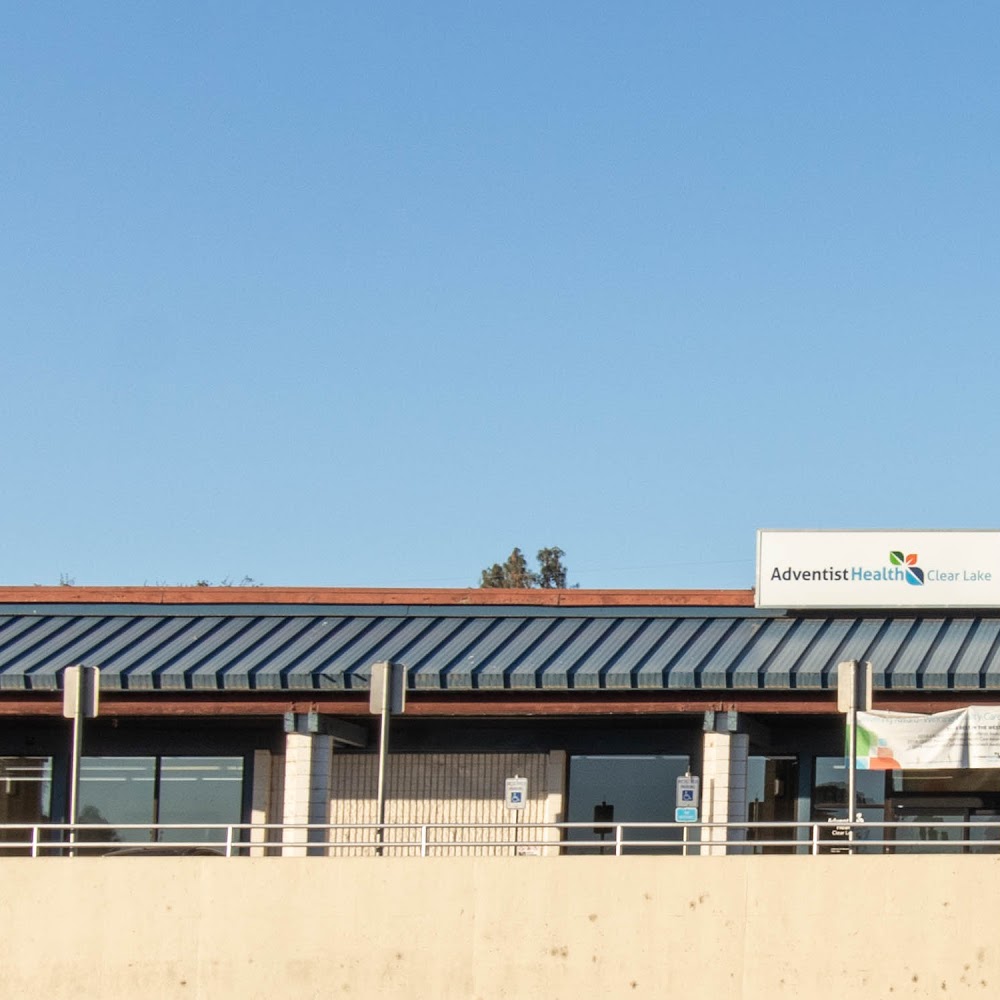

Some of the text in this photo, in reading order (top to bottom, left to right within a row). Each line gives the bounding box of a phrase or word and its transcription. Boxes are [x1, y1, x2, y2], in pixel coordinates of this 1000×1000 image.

[770, 567, 992, 581] Adventist Health Clear Lake
